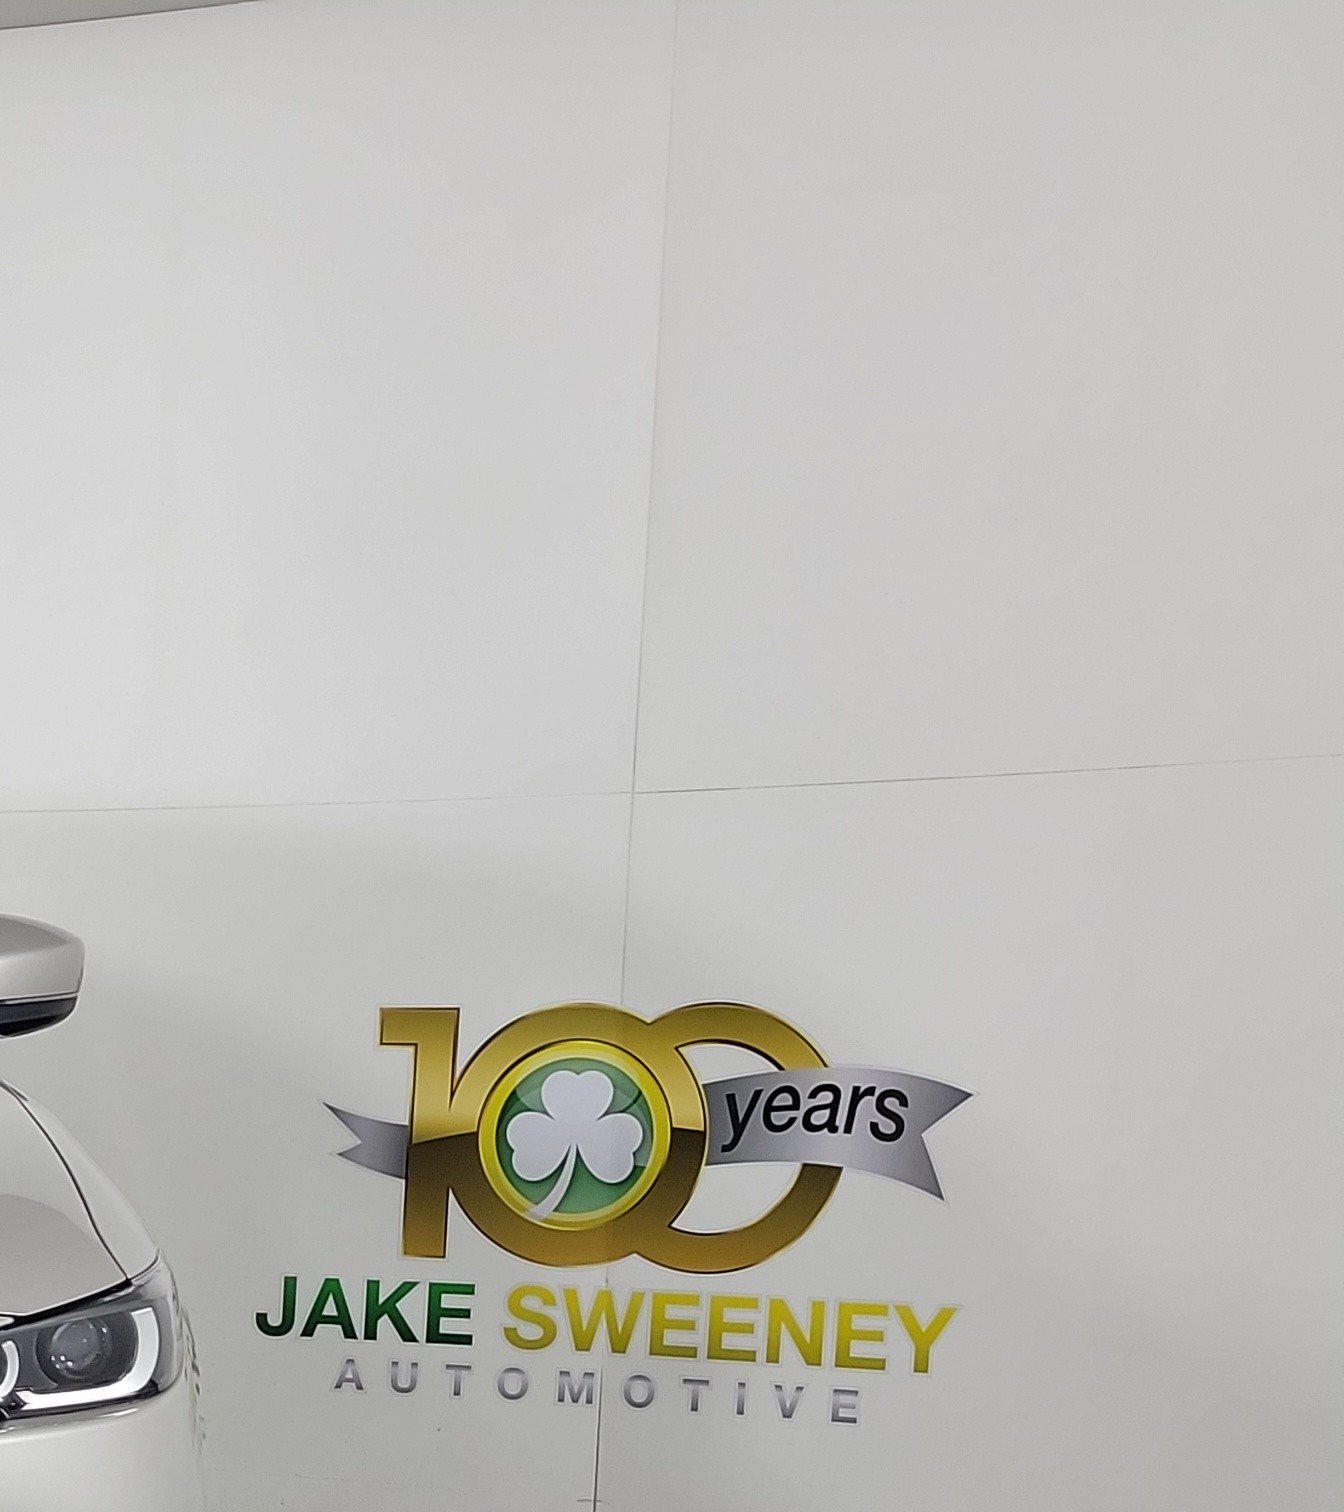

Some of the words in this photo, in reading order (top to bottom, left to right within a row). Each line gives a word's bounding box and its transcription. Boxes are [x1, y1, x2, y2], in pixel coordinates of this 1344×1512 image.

[378, 1002, 843, 1275] 100
[720, 1083, 909, 1153] years
[254, 1276, 477, 1346] JAKE
[502, 1285, 957, 1375] SWEENEY
[333, 1358, 859, 1426] AUTOMOTIVE
